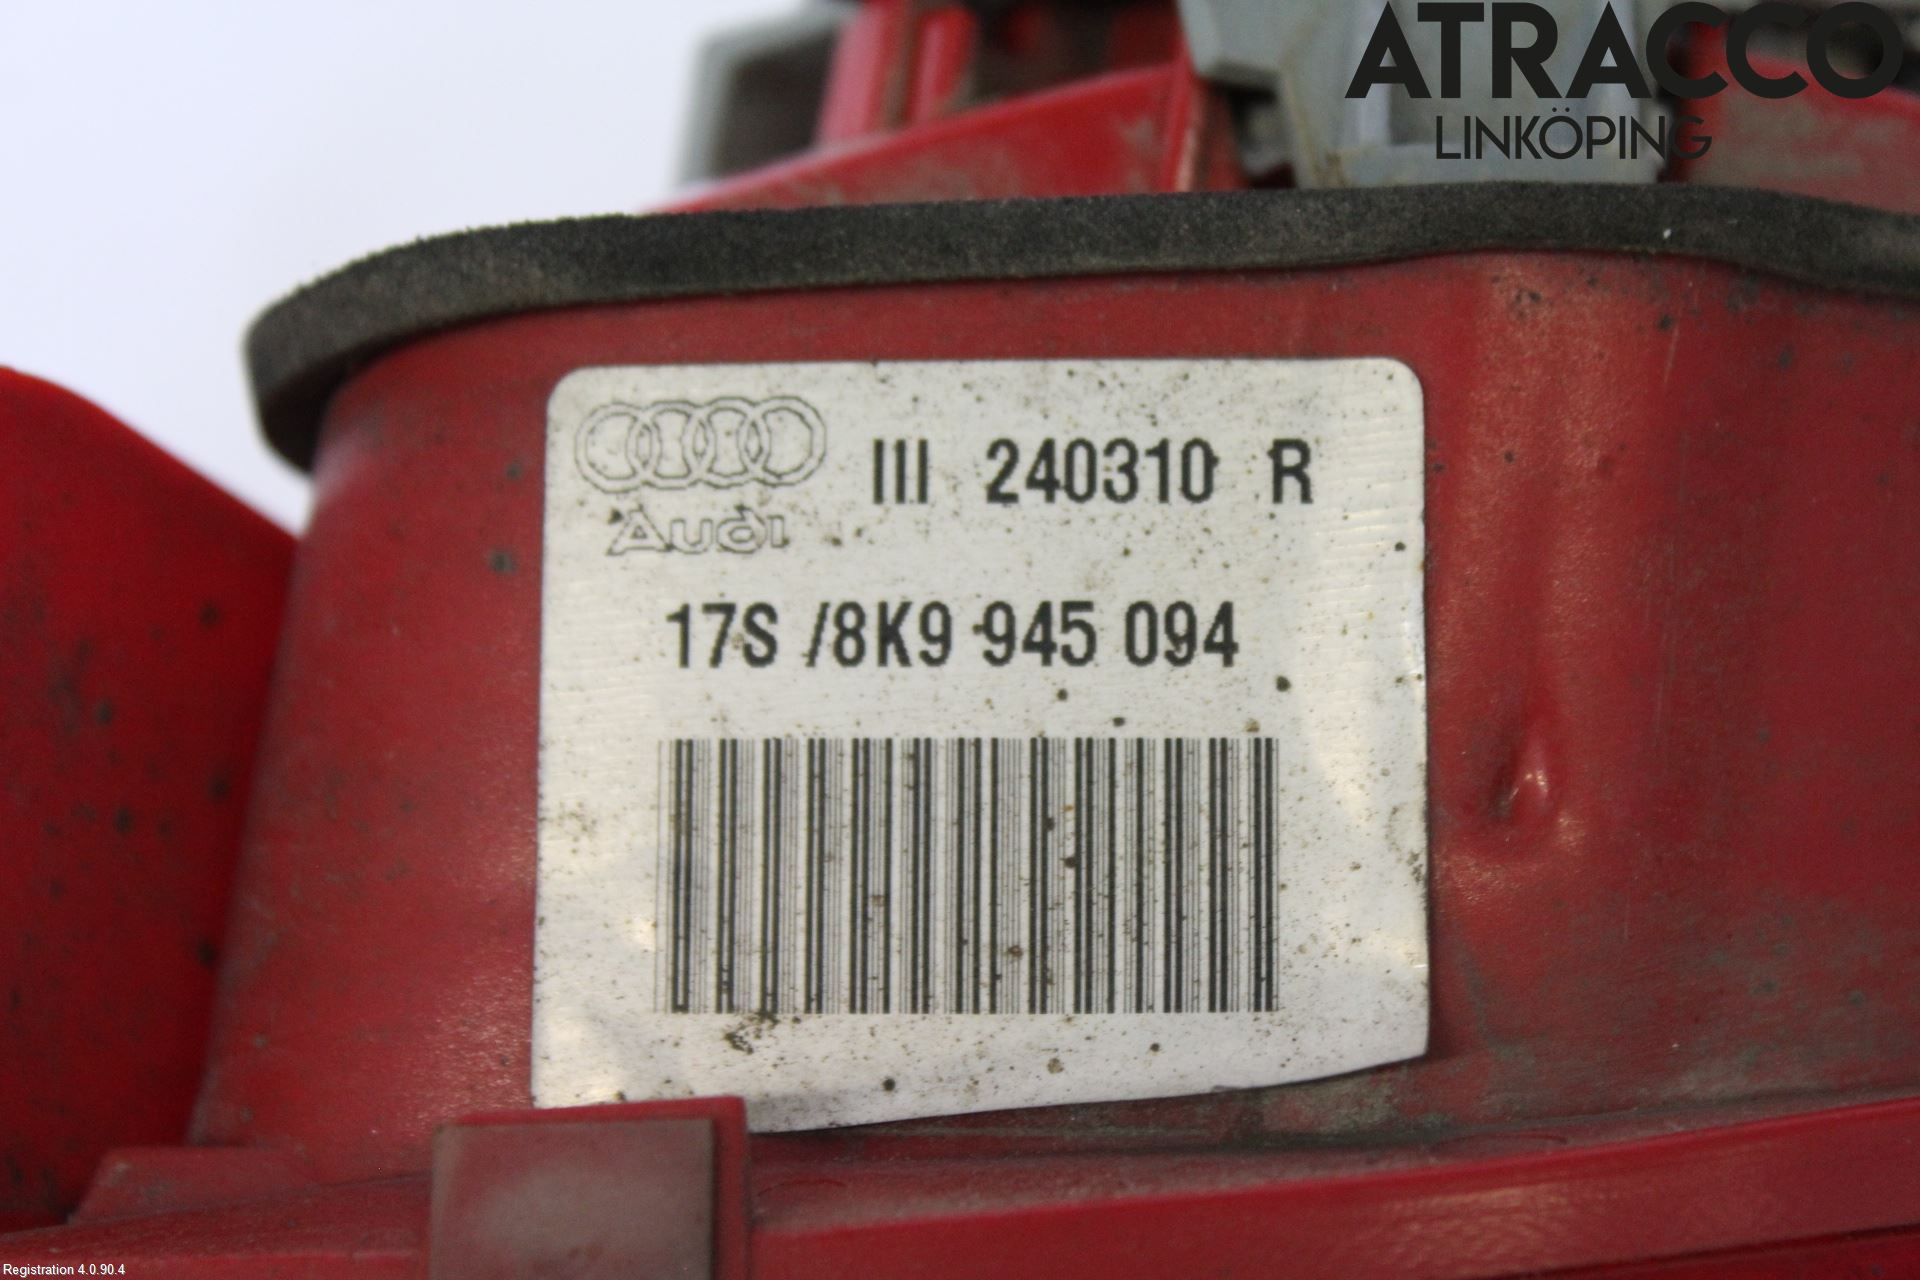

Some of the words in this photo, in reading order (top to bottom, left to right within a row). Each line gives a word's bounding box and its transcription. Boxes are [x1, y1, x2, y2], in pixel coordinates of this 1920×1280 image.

[986, 436, 1216, 505] 240310
[1269, 437, 1314, 505] R
[606, 504, 787, 555] Audi
[667, 602, 778, 668] 17S
[803, 602, 953, 668] /8K9
[980, 601, 1097, 668] 945
[1125, 601, 1240, 668] 094
